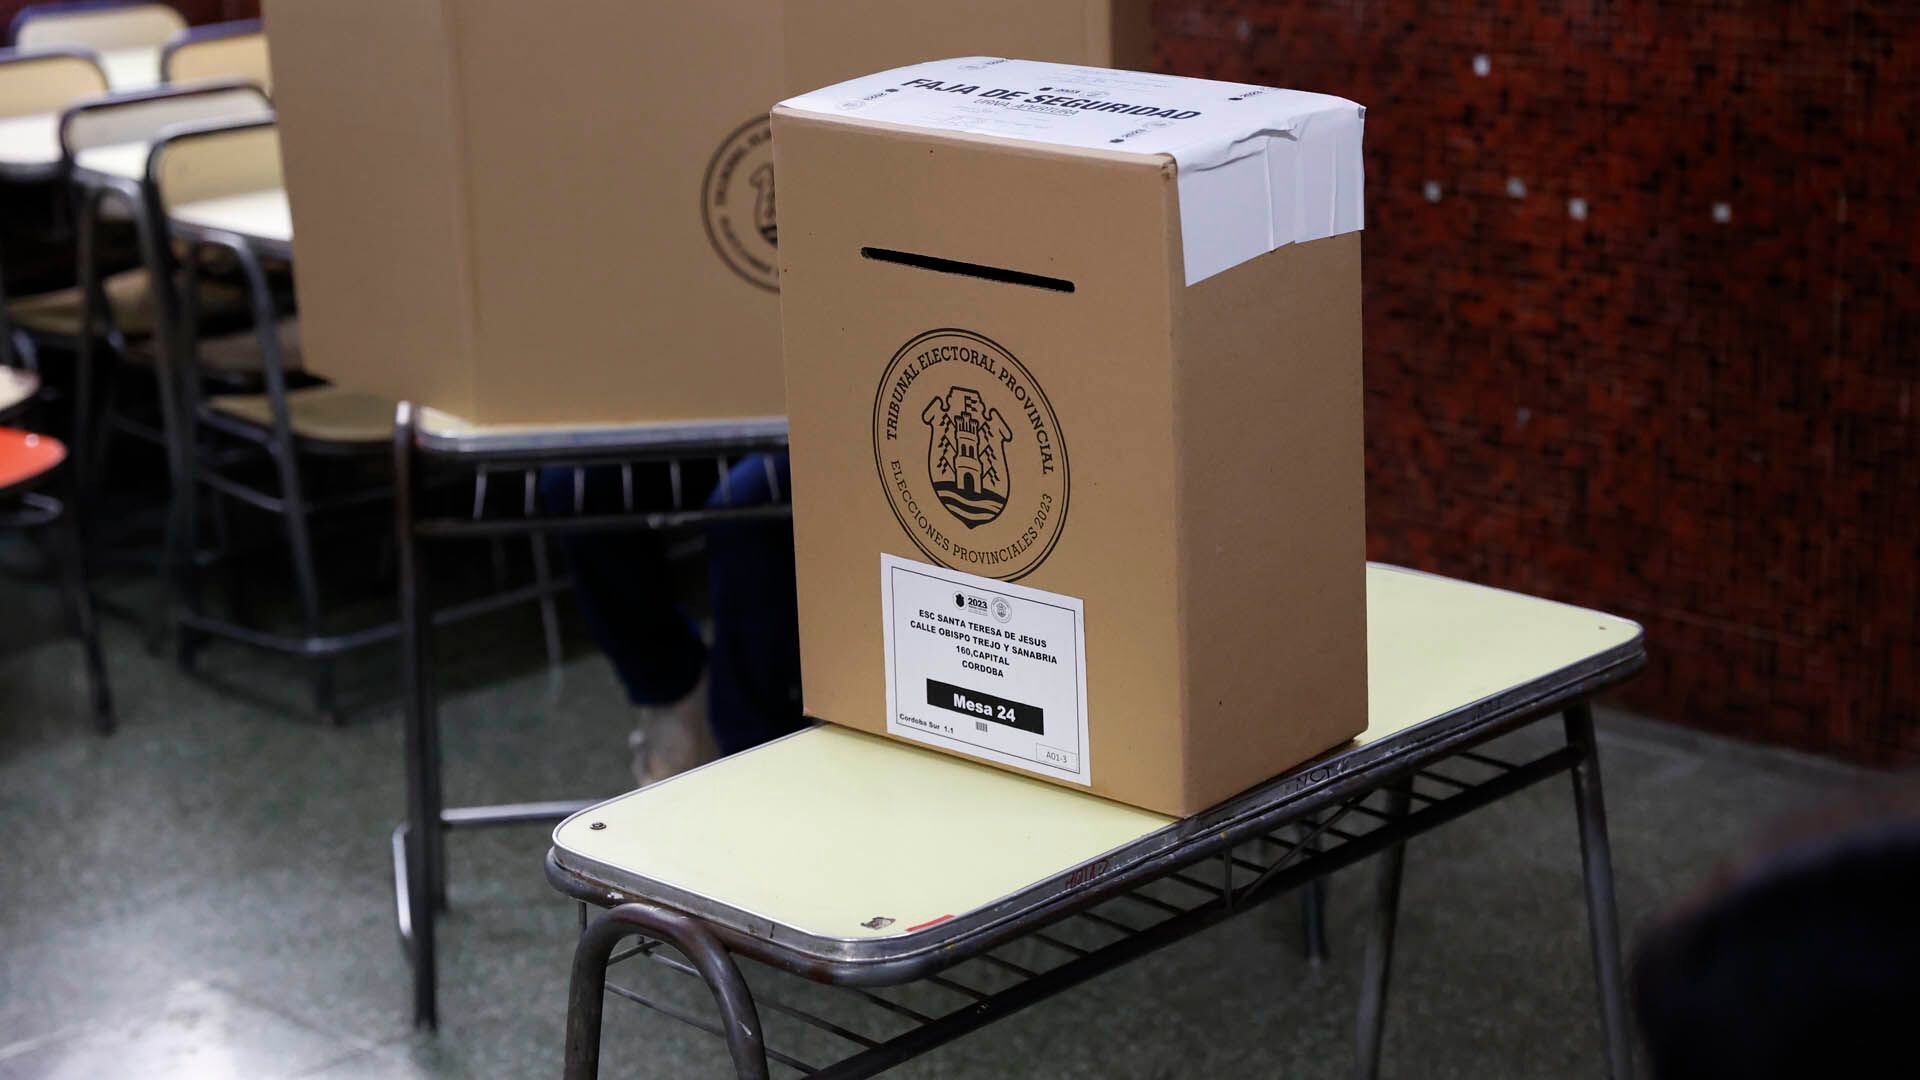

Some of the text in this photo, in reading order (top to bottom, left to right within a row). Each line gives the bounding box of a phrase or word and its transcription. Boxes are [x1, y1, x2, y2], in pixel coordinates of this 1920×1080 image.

[900, 78, 1202, 121] FAJA DE SEGURIDAD
[886, 346, 1054, 475] TRIBUNAL ELECTORAL PROVINCIAL
[890, 460, 1053, 565] ELECCIONES PROVINCIALES 2023
[967, 597, 988, 608] 2023
[910, 620, 1058, 665] CALLE OBISPO TREJO Y SANABRIA
[919, 609, 1047, 649] ESC SANTA TERESA DE JESUS
[956, 645, 1010, 667] 160,CAPITAL
[961, 659, 1004, 678] CORDOBA
[953, 693, 1017, 723] Mesa 24
